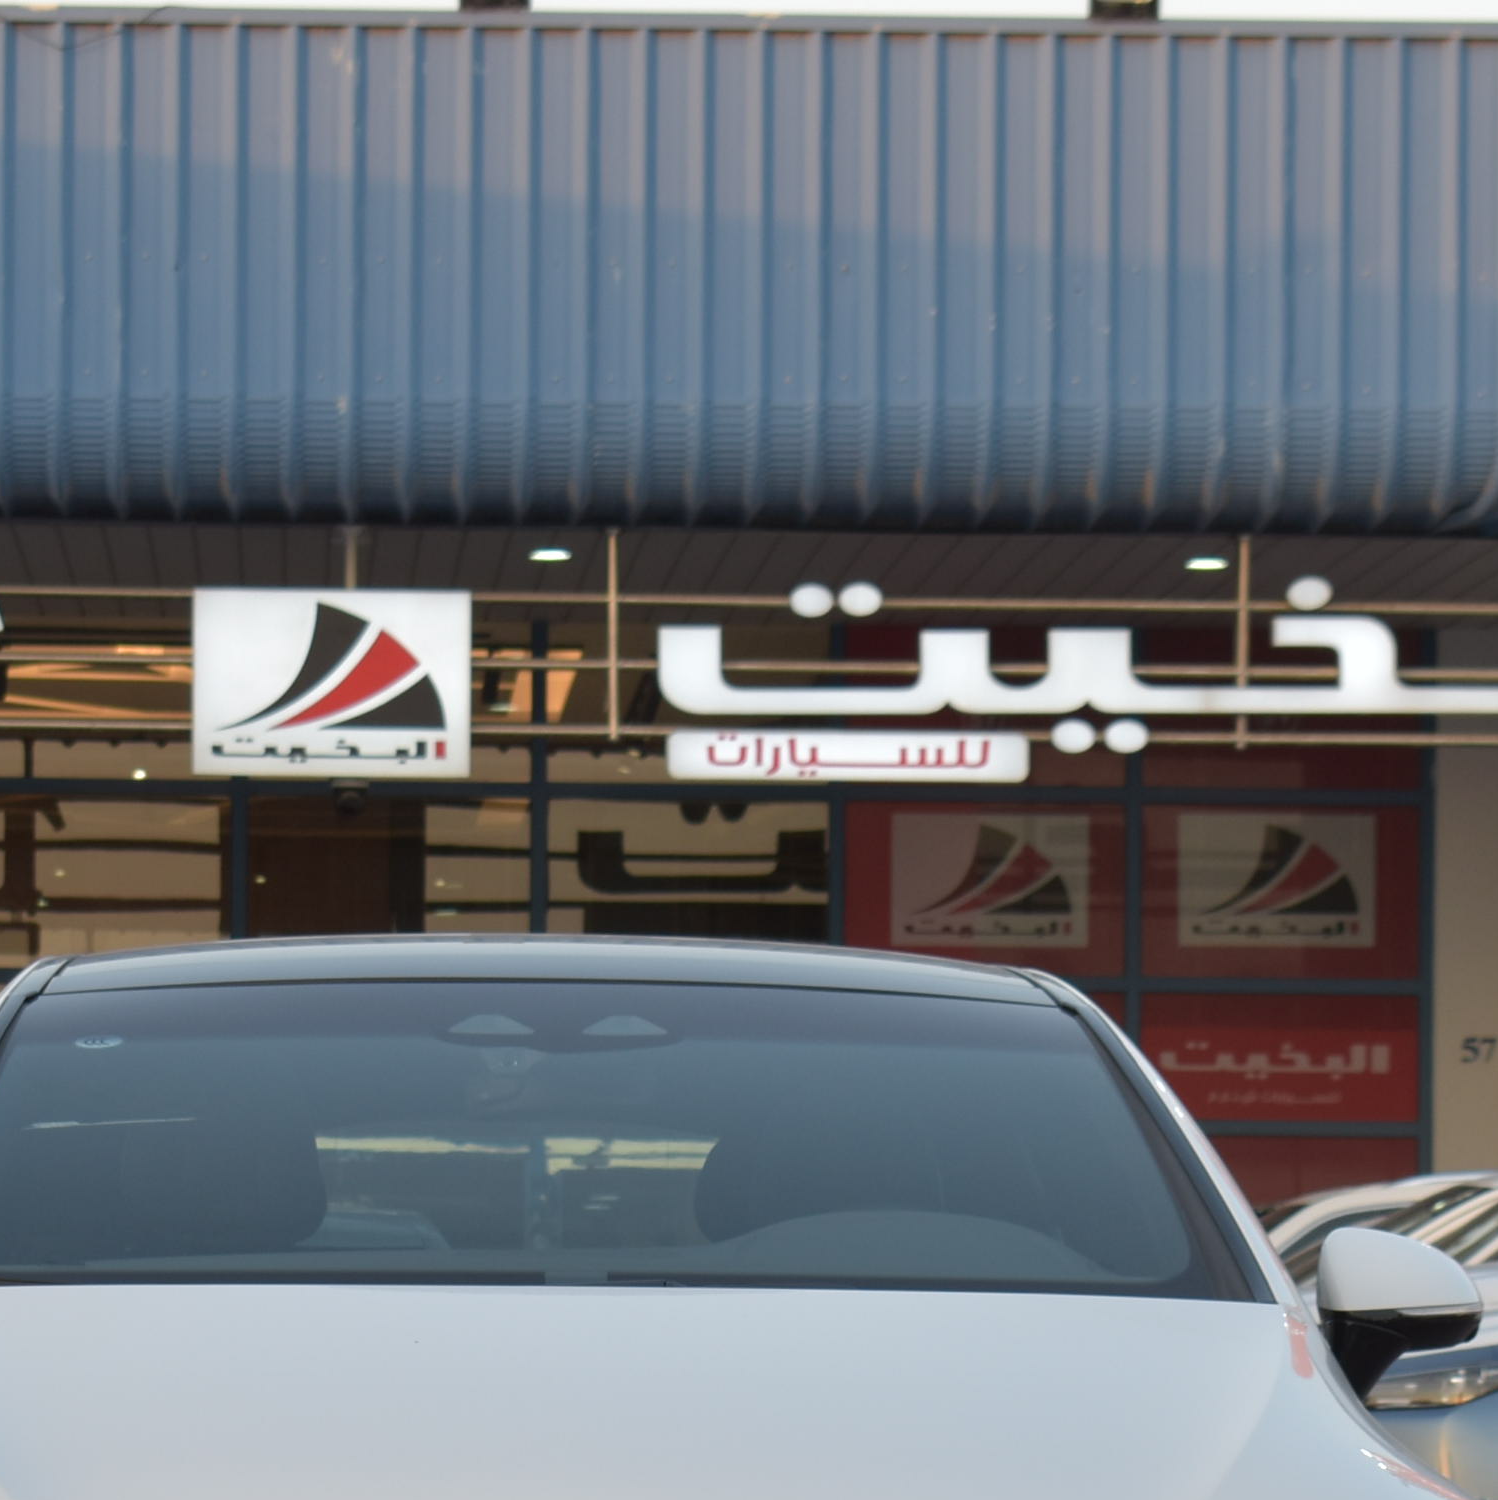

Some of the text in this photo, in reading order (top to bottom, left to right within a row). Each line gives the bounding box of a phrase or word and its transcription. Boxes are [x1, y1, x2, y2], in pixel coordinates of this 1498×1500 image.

[211, 737, 448, 765] البخيت
[706, 732, 991, 777] للسيارات
[1159, 1040, 1390, 1081] البخيت
[1460, 1037, 1498, 1064] 57
